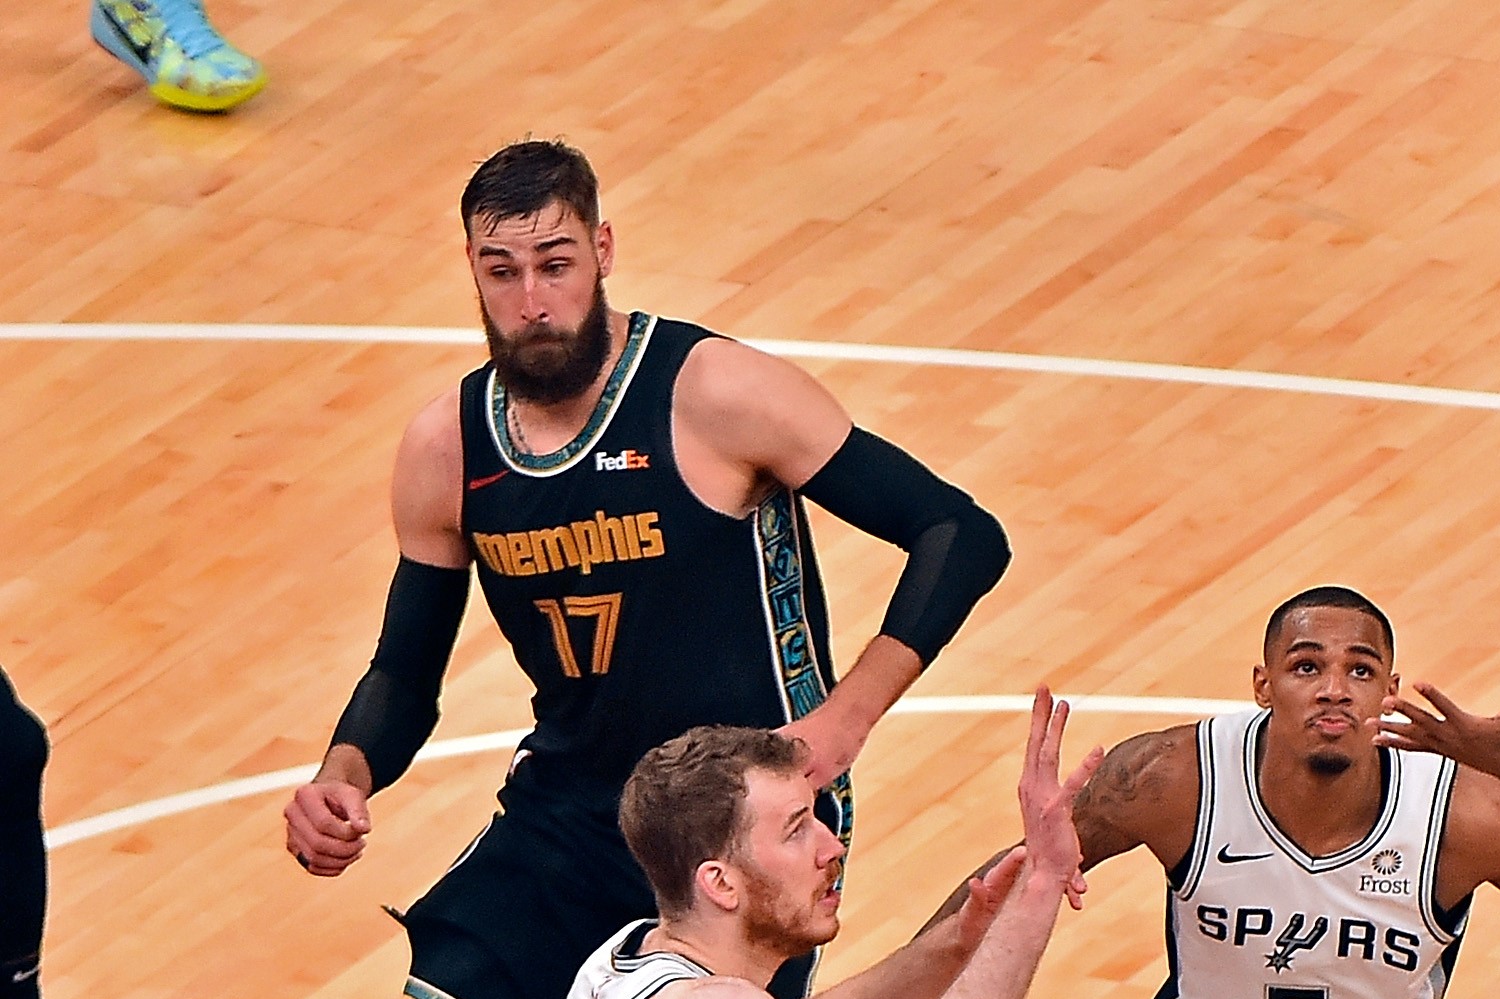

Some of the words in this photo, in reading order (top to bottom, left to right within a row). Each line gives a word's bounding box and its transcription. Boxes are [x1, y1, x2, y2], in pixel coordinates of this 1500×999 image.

[595, 449, 650, 471] FedEx
[473, 510, 666, 577] memphis
[532, 591, 624, 679] 17
[1359, 874, 1411, 895] Frost
[1196, 904, 1421, 974] SPURS
